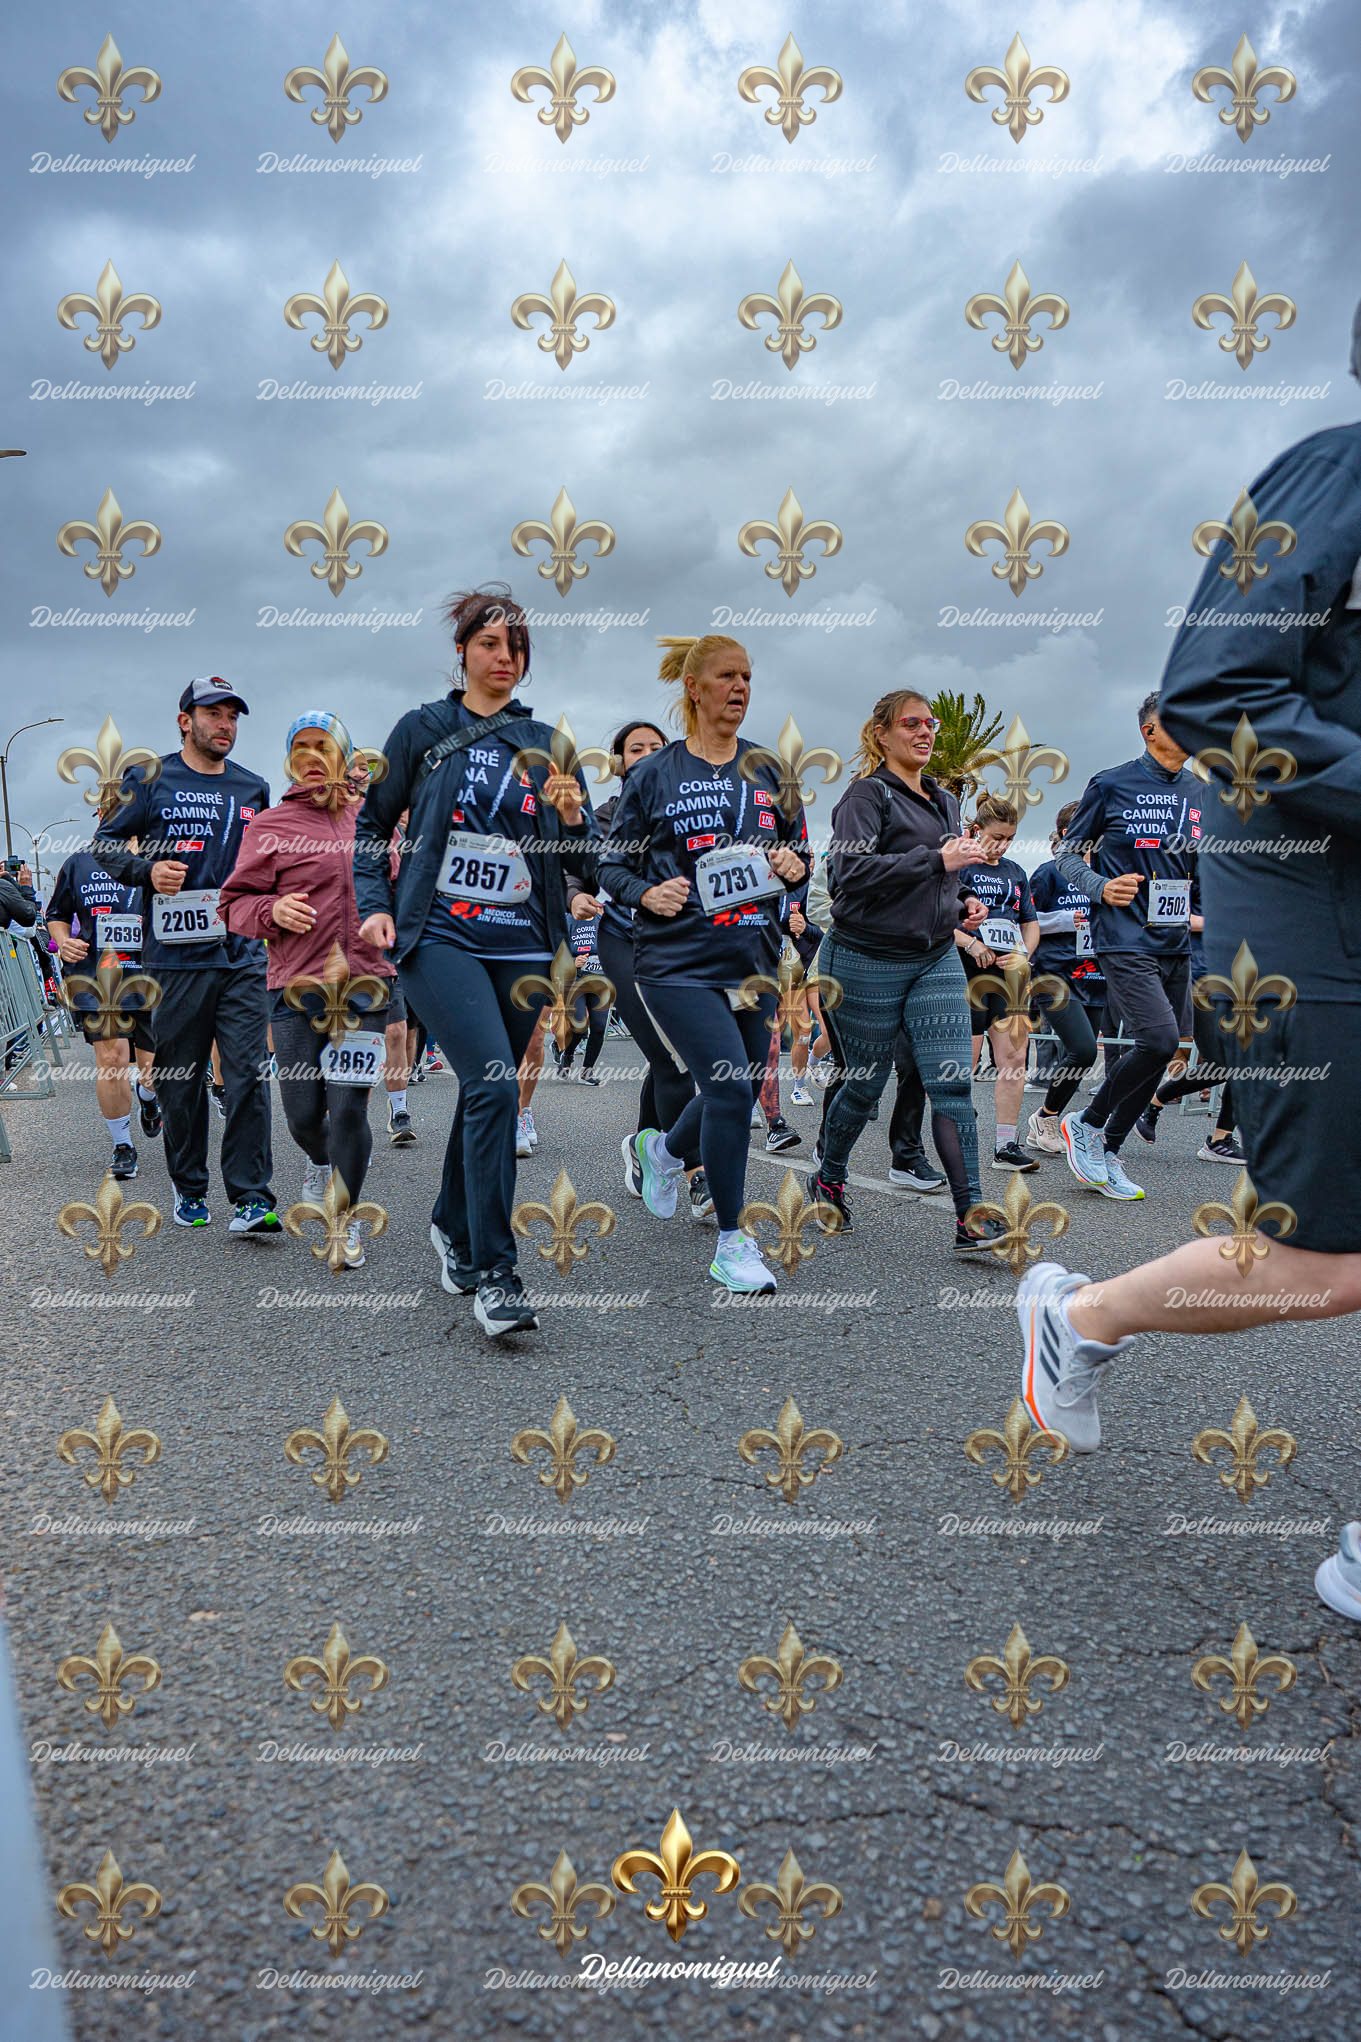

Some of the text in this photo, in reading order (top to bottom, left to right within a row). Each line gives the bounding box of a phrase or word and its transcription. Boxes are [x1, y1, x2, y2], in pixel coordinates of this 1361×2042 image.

[436, 710, 513, 757] UNE PRUNE
[467, 749, 499, 767] RRÉ
[680, 778, 734, 794] CORRÉ
[175, 791, 223, 805] CORRÉ
[665, 793, 732, 817] CAMINÁ
[1136, 793, 1178, 806] CORRÉ
[161, 806, 220, 820] CAMINÁ
[1122, 807, 1174, 820] CAMINÁ
[168, 822, 214, 836] AYUDÁ
[673, 810, 725, 835] AYUDÁ
[1125, 822, 1168, 835] AYUDÁ
[449, 856, 510, 892] 2857
[708, 864, 759, 899] 2731
[971, 885, 1003, 895] AMINÁ
[84, 893, 119, 906] AYUDÁ
[1057, 894, 1090, 905] CAMIN
[1157, 896, 1186, 916] 2502
[162, 909, 209, 933] 2205
[104, 926, 142, 943] 2639
[988, 928, 1016, 945] 2744
[328, 1050, 376, 1075] 2862
